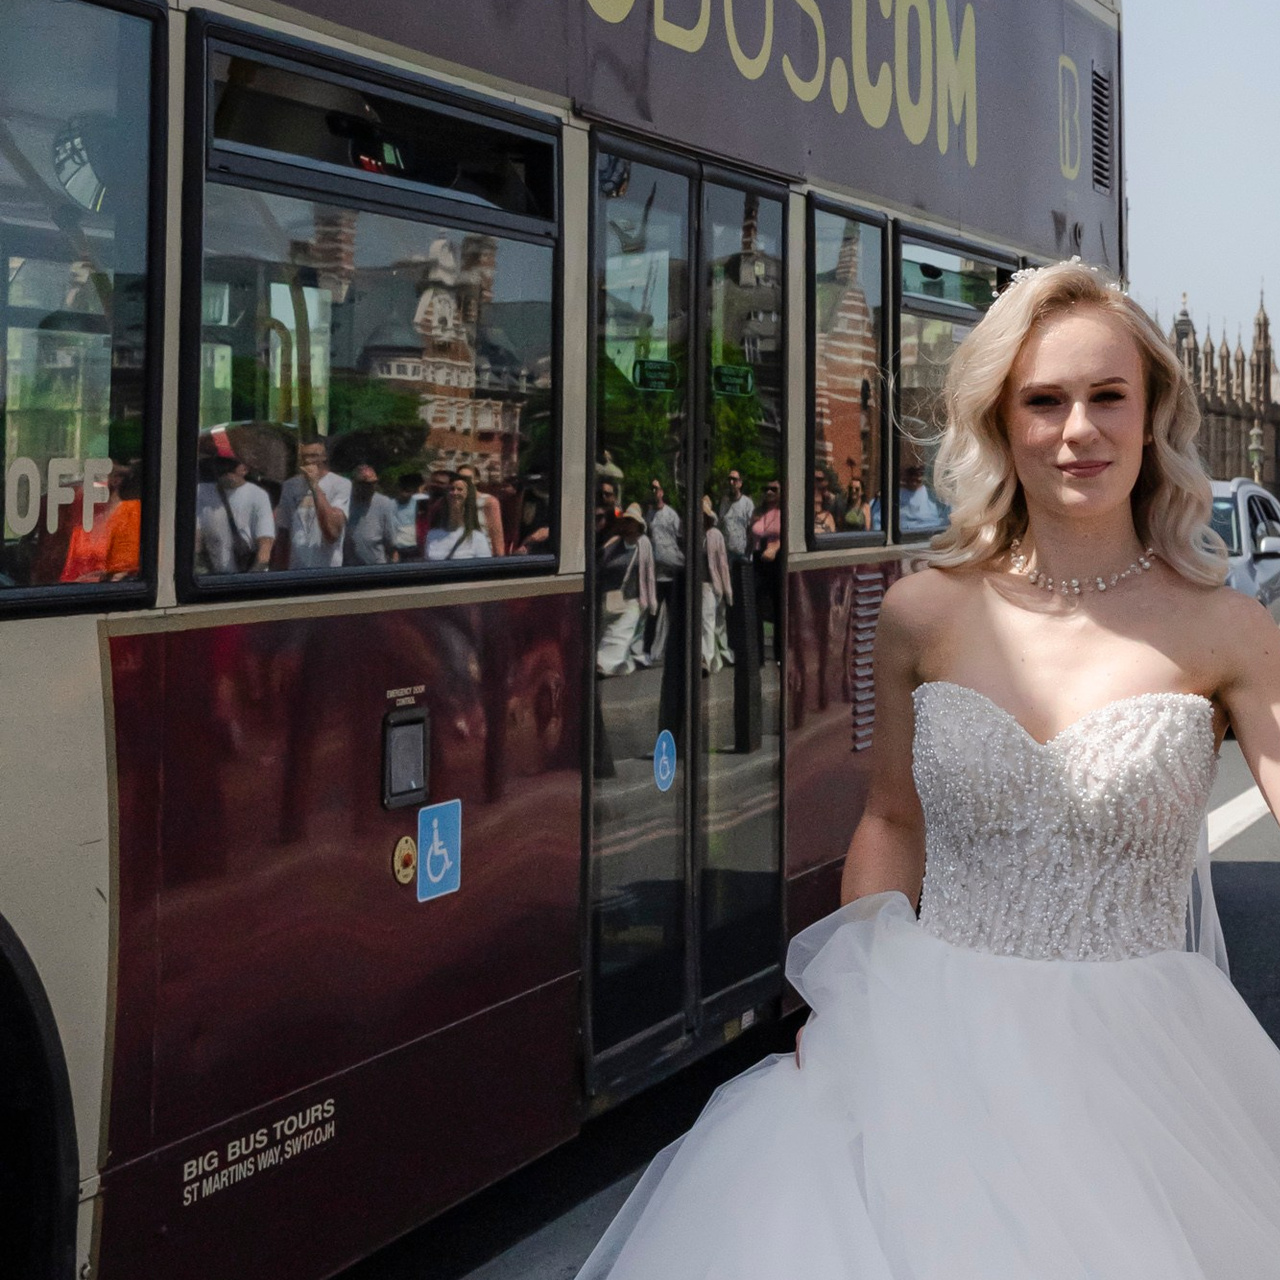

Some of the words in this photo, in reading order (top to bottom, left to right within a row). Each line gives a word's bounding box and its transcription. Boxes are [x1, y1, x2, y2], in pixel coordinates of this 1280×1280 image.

[4, 456, 114, 536] OFF
[183, 1150, 219, 1182] BIG
[227, 1128, 268, 1162] BUS
[272, 1098, 335, 1140] TOURS
[183, 1182, 200, 1206] ST
[202, 1157, 255, 1198] MARTINS
[257, 1145, 284, 1171] WAY,
